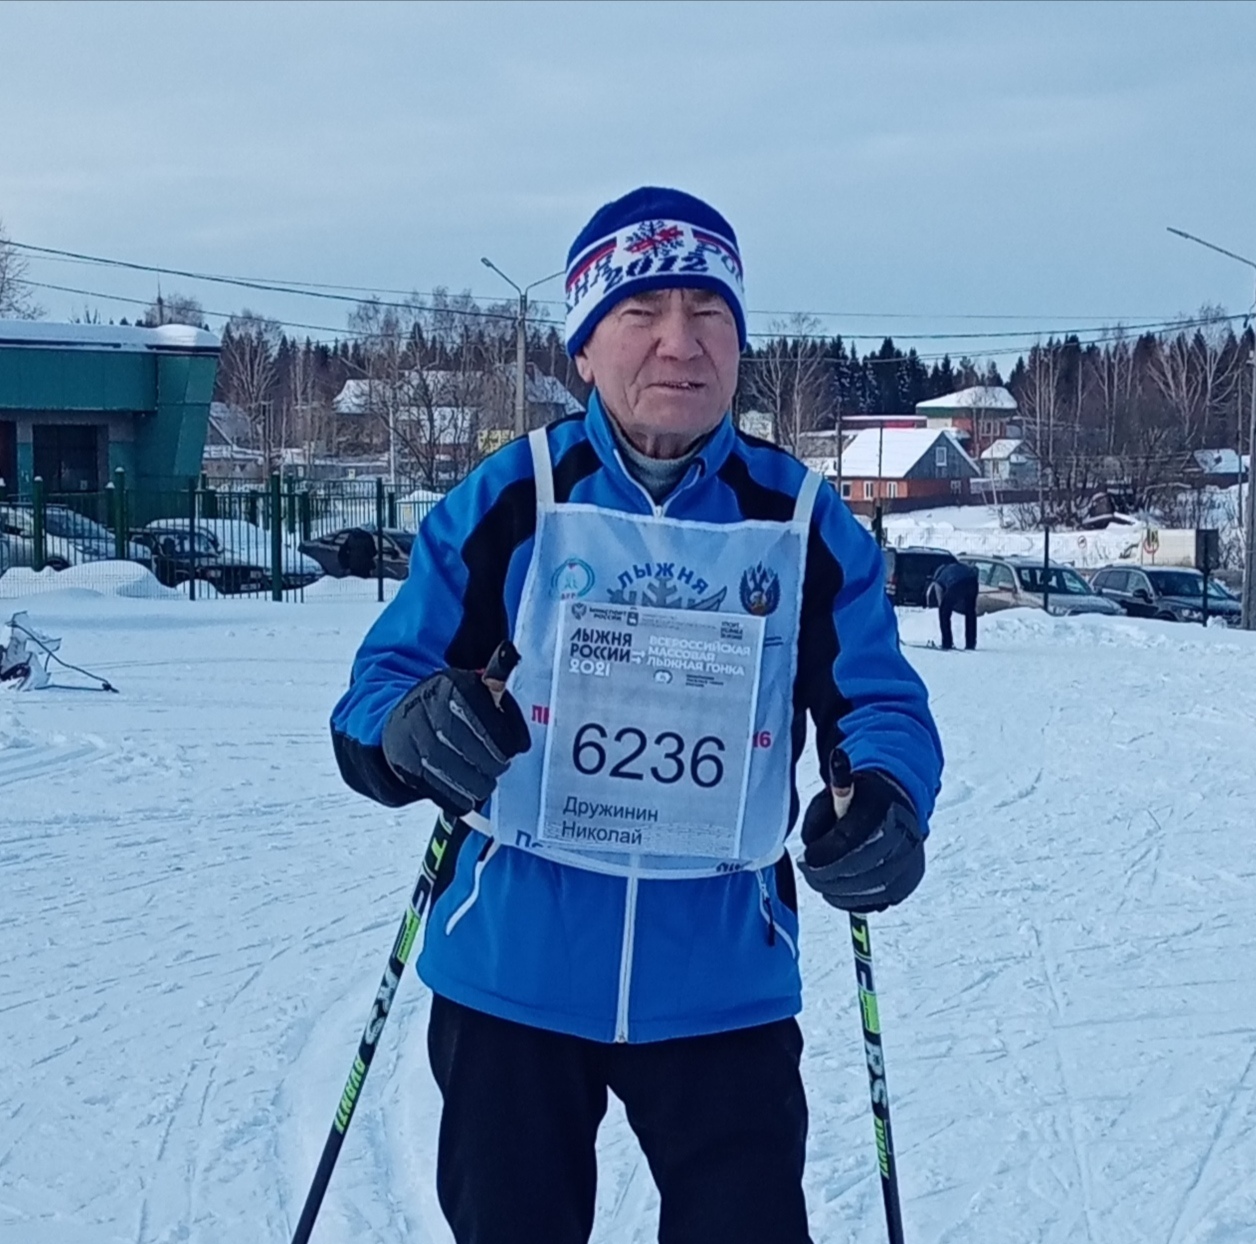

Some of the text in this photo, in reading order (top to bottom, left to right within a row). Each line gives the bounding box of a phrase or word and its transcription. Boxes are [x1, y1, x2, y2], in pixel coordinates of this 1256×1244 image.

[602, 255, 709, 294] 2012
[616, 562, 709, 595] ЛЫЖНЯ
[570, 627, 632, 647] ЛЫЖНЯ
[650, 635, 751, 656] ВСЕРОССИЙСКАЯ
[570, 643, 631, 663] РОССИИ
[648, 646, 716, 662] МАССОВАЯ
[569, 659, 610, 676] 2021
[647, 656, 745, 676] ЛЫЖНАЯ ГОНКА
[572, 723, 726, 787] 6236
[562, 795, 659, 822] Дружинин
[561, 820, 643, 845] Николай
